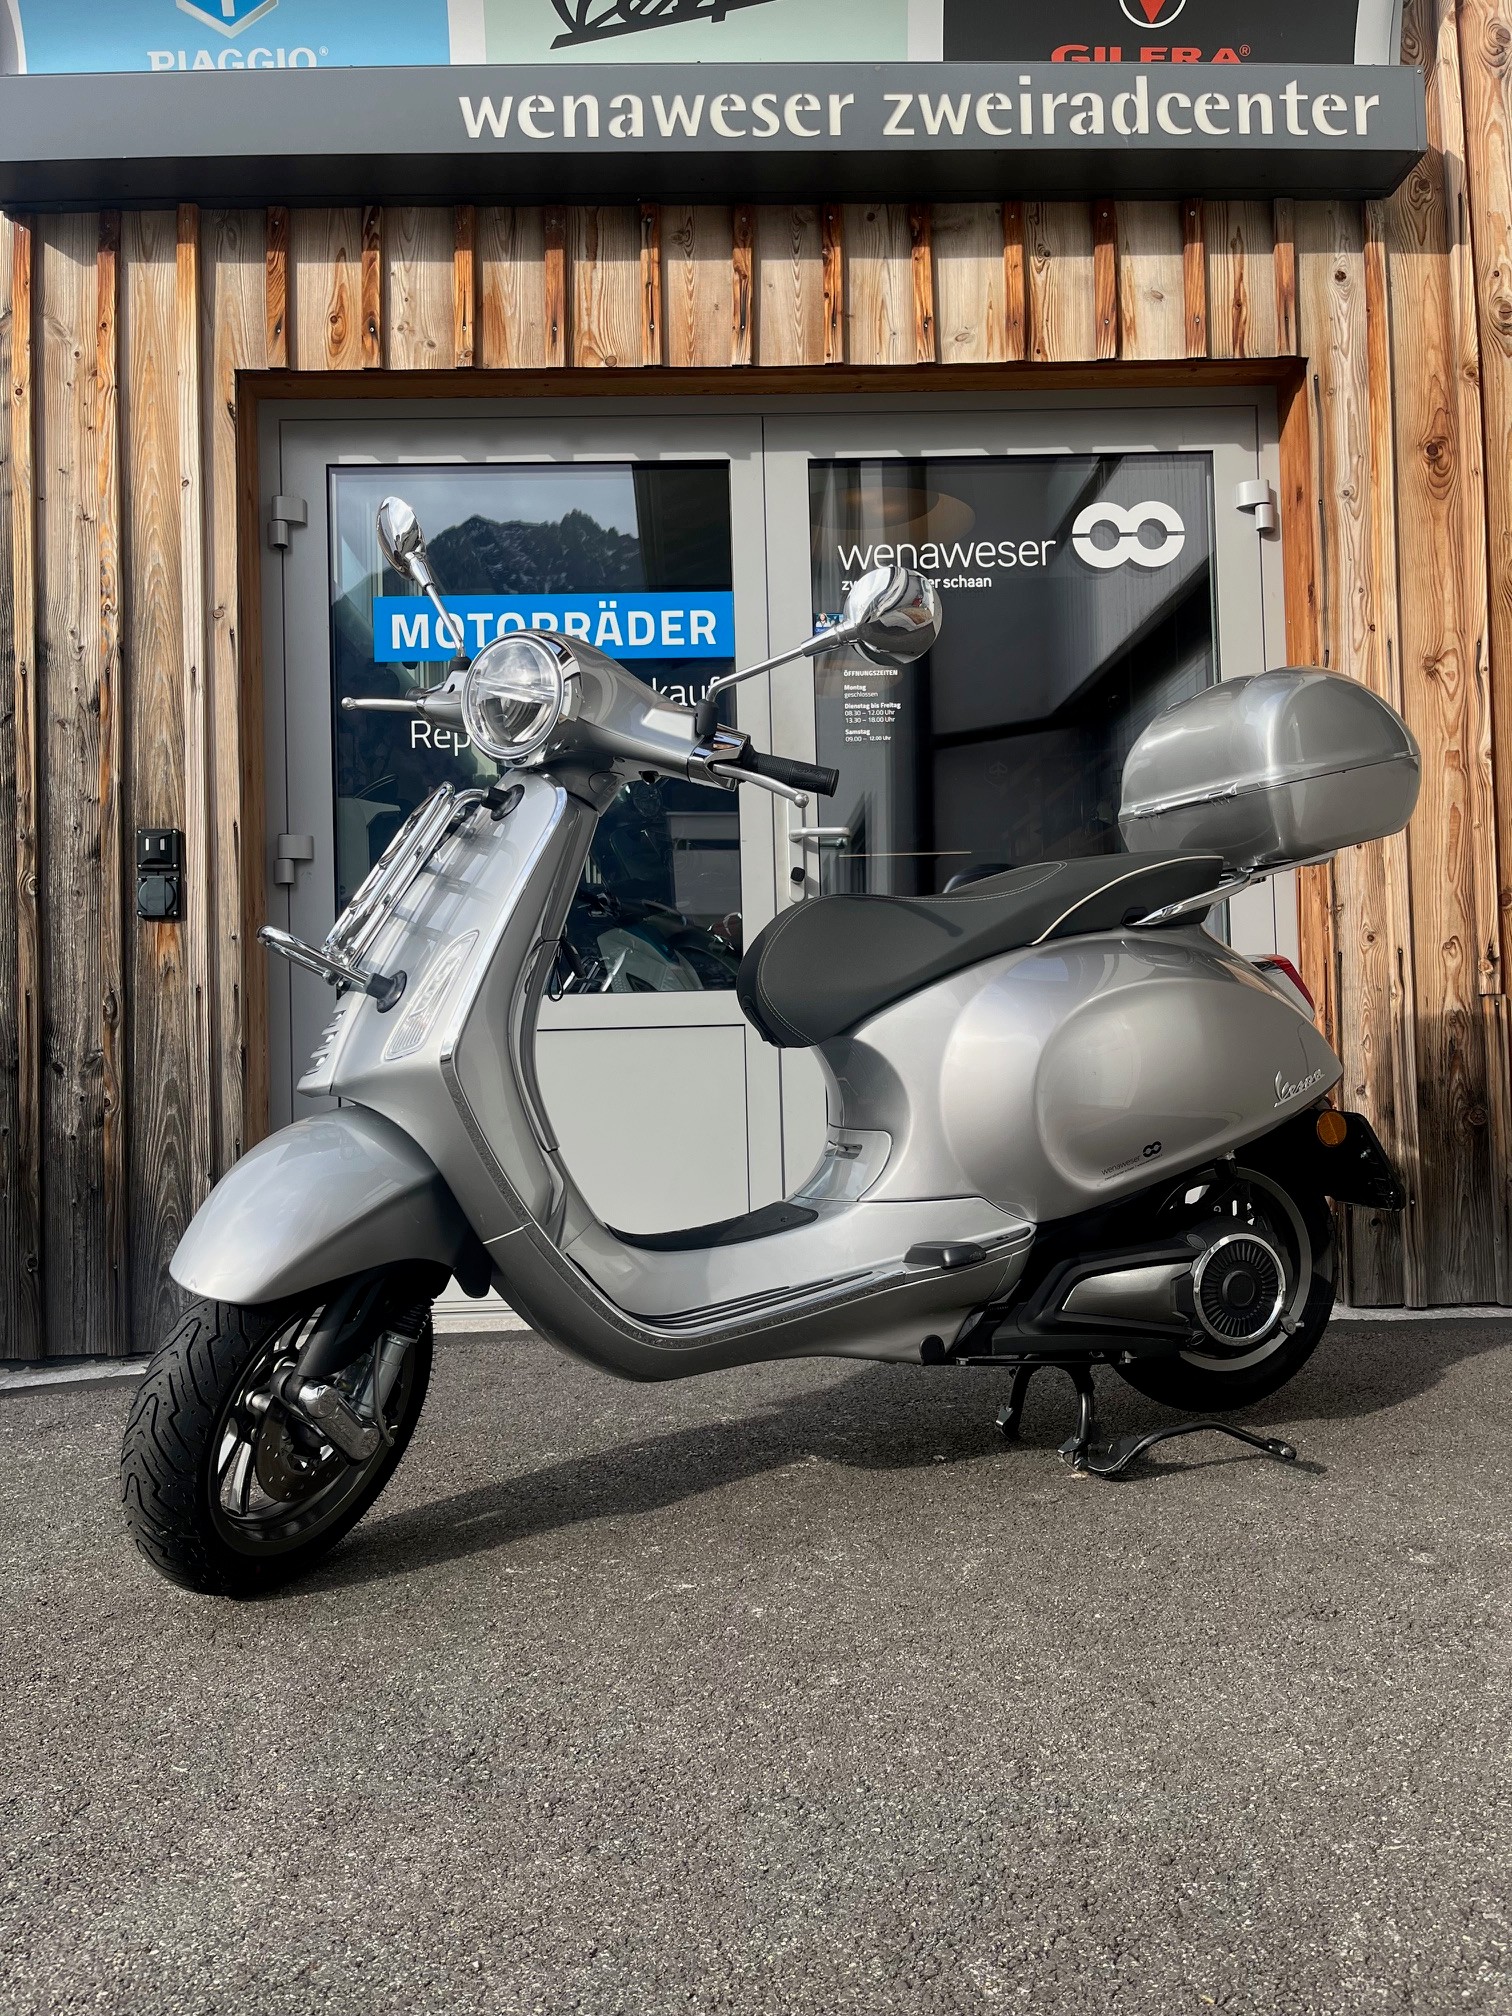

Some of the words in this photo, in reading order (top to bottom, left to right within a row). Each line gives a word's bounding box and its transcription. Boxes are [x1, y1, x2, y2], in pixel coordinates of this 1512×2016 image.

[458, 93, 855, 139] wenaweser
[882, 75, 1380, 136] zweiradcenter
[837, 540, 1057, 570] wenaweser
[943, 575, 992, 589] schaan
[880, 702, 901, 710] Freitag
[411, 720, 471, 757] Rep
[1273, 1069, 1326, 1108] Vespa
